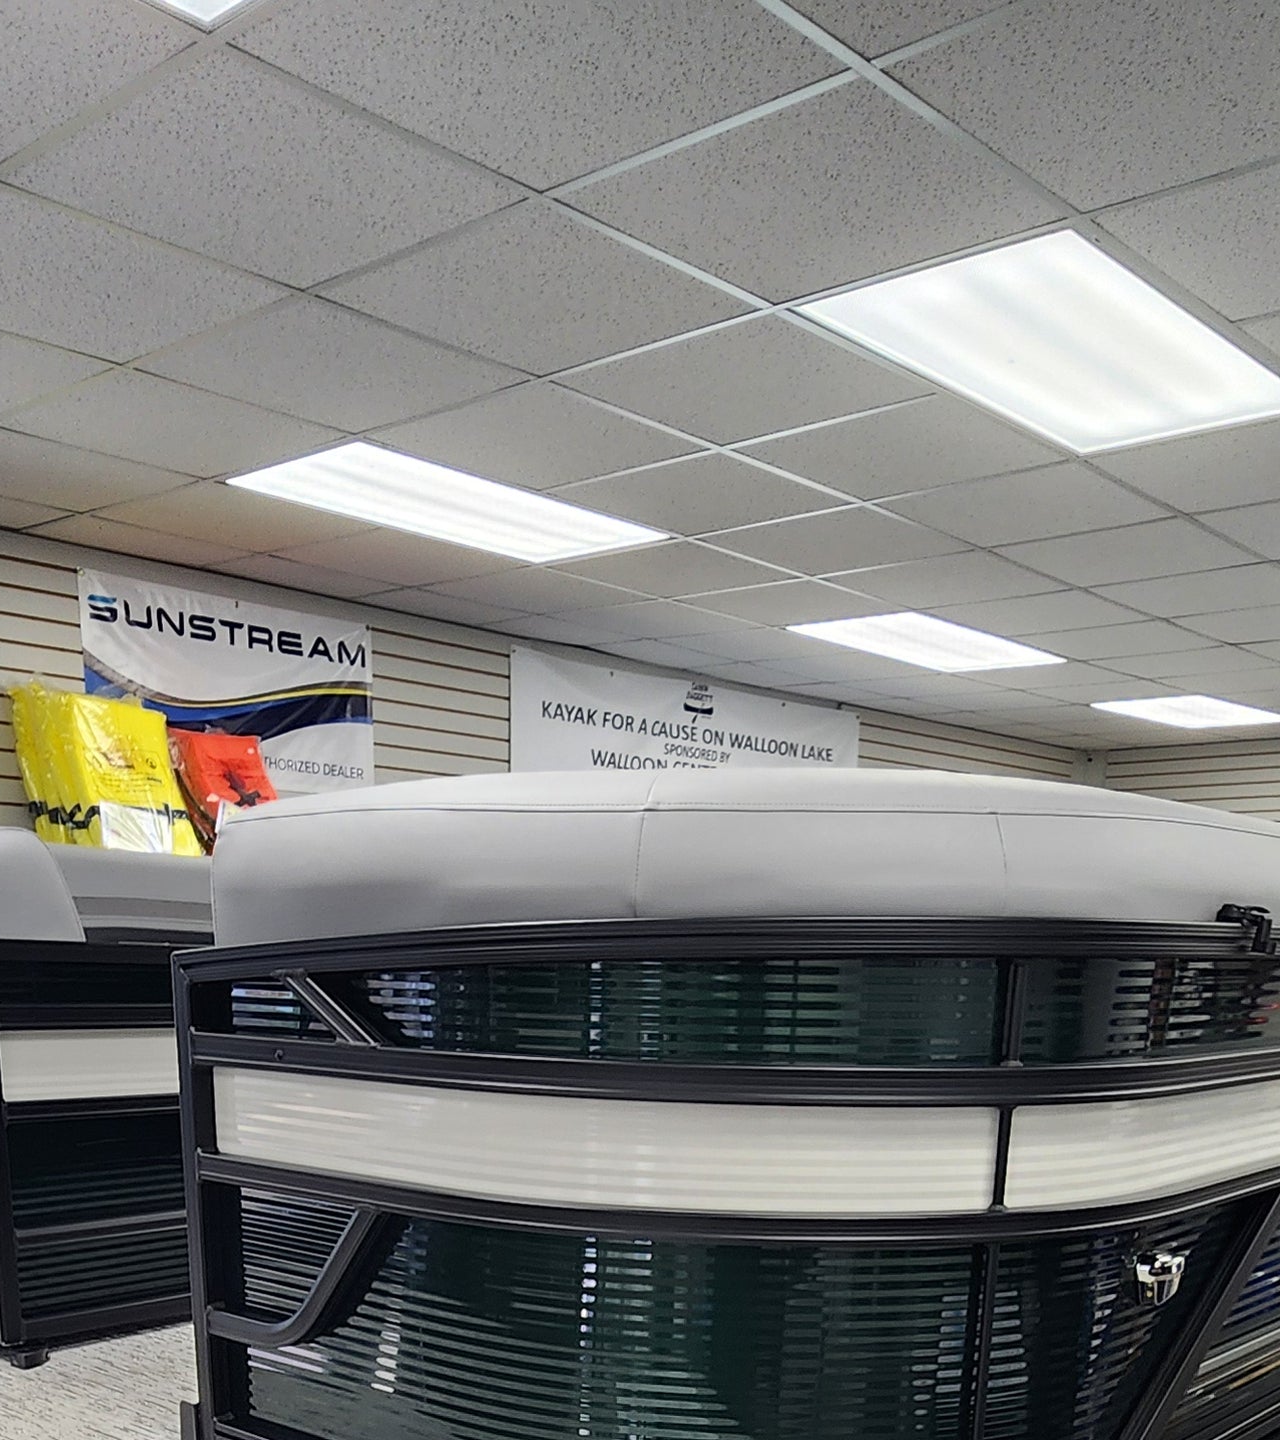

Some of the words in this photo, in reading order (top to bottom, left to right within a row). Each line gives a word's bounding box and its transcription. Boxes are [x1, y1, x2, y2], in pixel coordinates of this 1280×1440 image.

[87, 593, 367, 668] SUNSTREAM
[541, 700, 596, 727] KAYAK
[602, 711, 634, 733] FOR
[637, 718, 648, 735] A
[651, 720, 698, 743] CAUSE
[702, 729, 725, 746] ON
[729, 732, 798, 759] WALLOON
[801, 744, 833, 763] LAKE
[663, 742, 718, 762] SPONSORED
[720, 751, 732, 763] BY
[264, 756, 320, 775] THORIZED
[322, 762, 365, 780] DEALER
